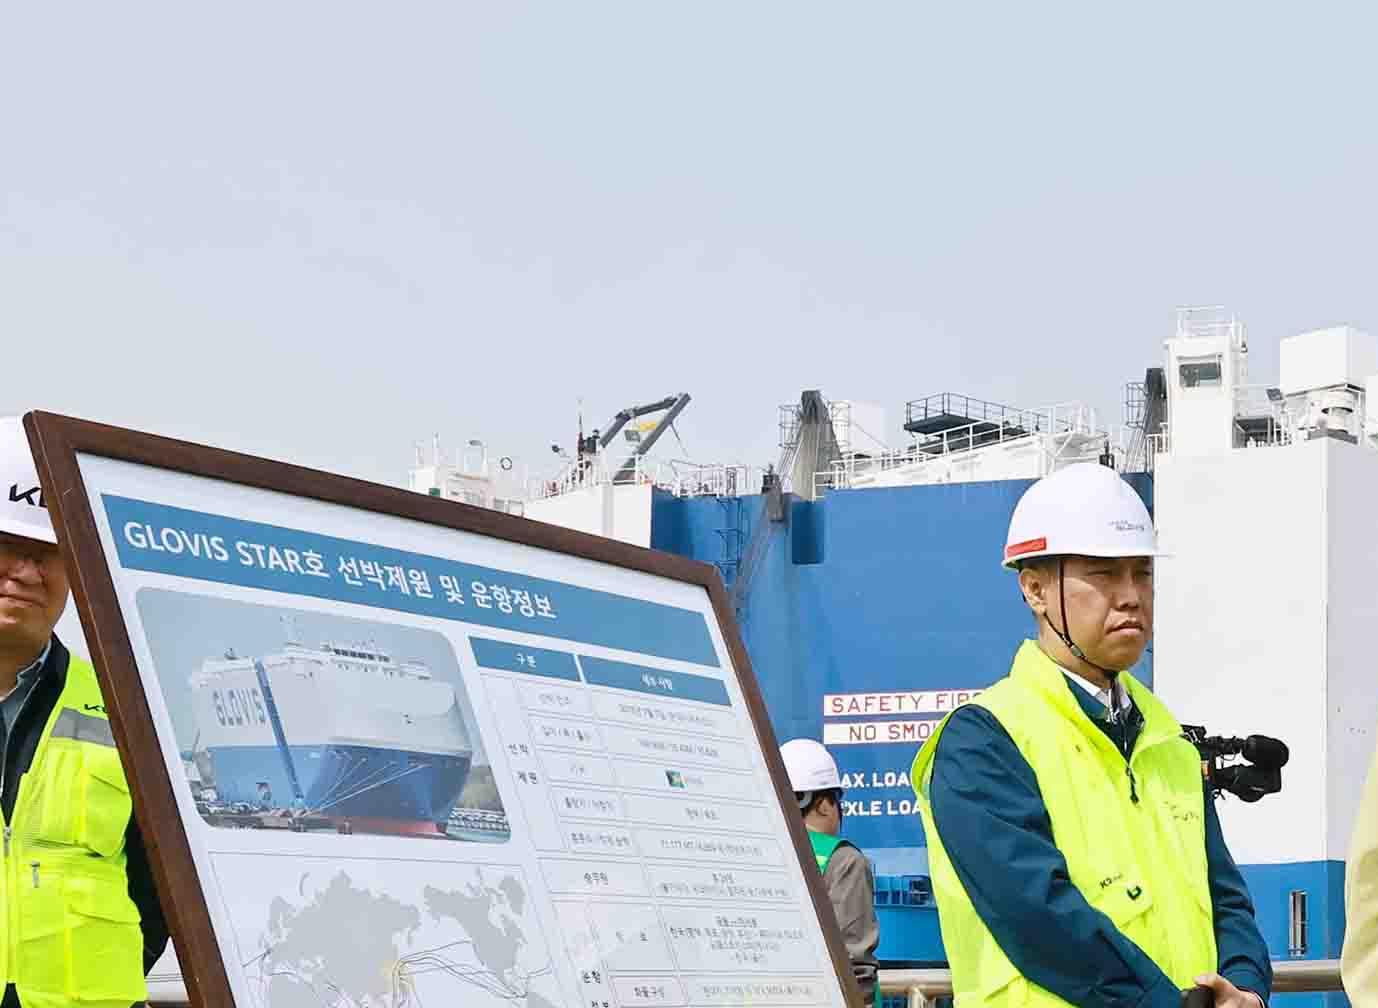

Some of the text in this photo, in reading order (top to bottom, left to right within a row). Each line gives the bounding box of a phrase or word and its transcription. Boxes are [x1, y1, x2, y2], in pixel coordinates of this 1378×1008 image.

[124, 521, 557, 619] GLOVIS STAR호 선박제원 및 운항정보
[832, 692, 983, 713] SAFETY FIR
[849, 723, 935, 741] NO SMO
[840, 799, 921, 817] XLE LOA
